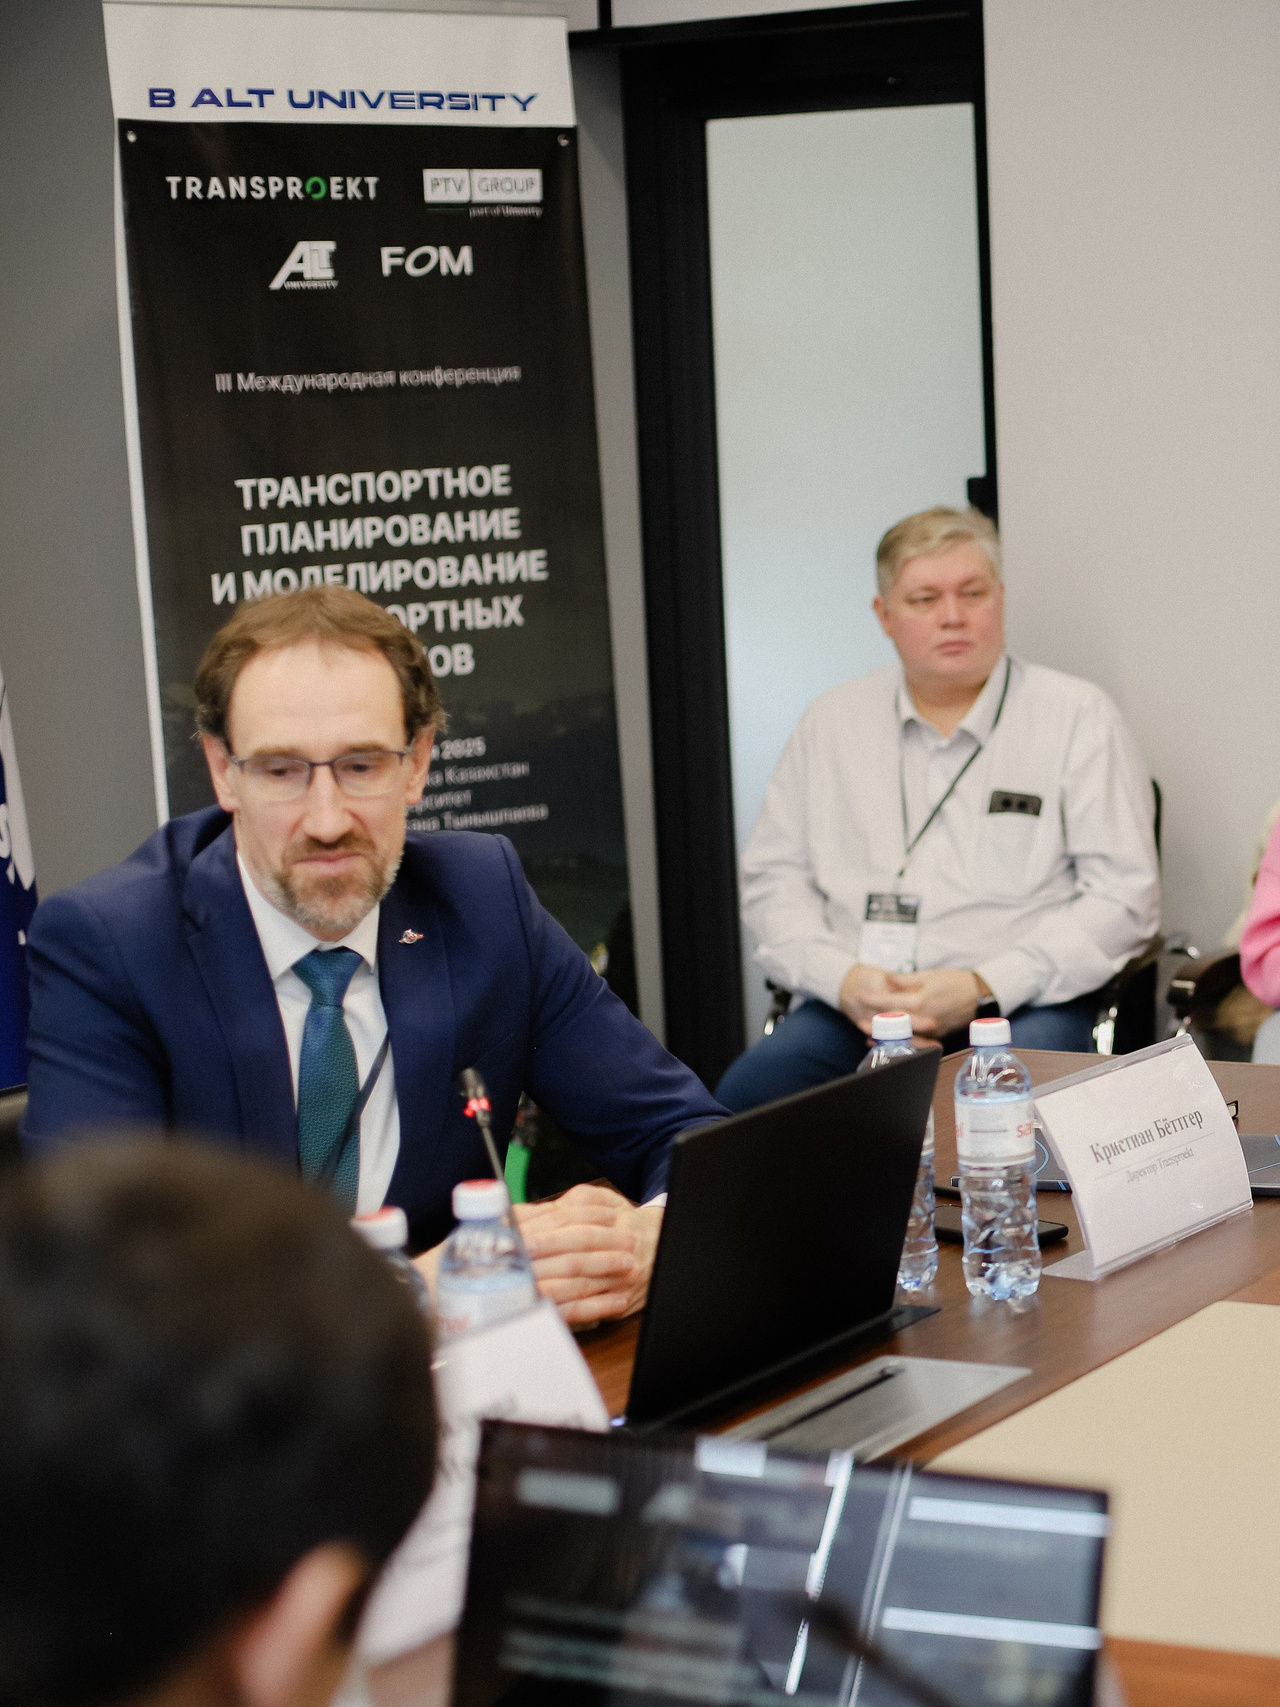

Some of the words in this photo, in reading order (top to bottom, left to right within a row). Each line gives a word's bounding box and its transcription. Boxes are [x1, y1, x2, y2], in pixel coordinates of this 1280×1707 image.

[148, 87, 176, 108] B
[190, 88, 275, 109] ALT
[287, 90, 538, 112] UNIVERSITY
[165, 176, 380, 201] TRANSPROEKT
[429, 177, 466, 194] PTV
[476, 176, 537, 194] GROUP
[380, 245, 474, 278] FOM
[236, 370, 397, 395] Международная
[398, 364, 522, 390] конференция
[234, 464, 513, 511] ТРАНСПОРТНОЕ
[240, 507, 522, 557] ПЛАНИРОВАНИЕ
[211, 570, 238, 606] И
[242, 549, 550, 601] МОДЕЛИРОВАНИЕ
[1090, 1128, 1155, 1165] Кристиан
[1153, 1110, 1204, 1139] Бёттгер
